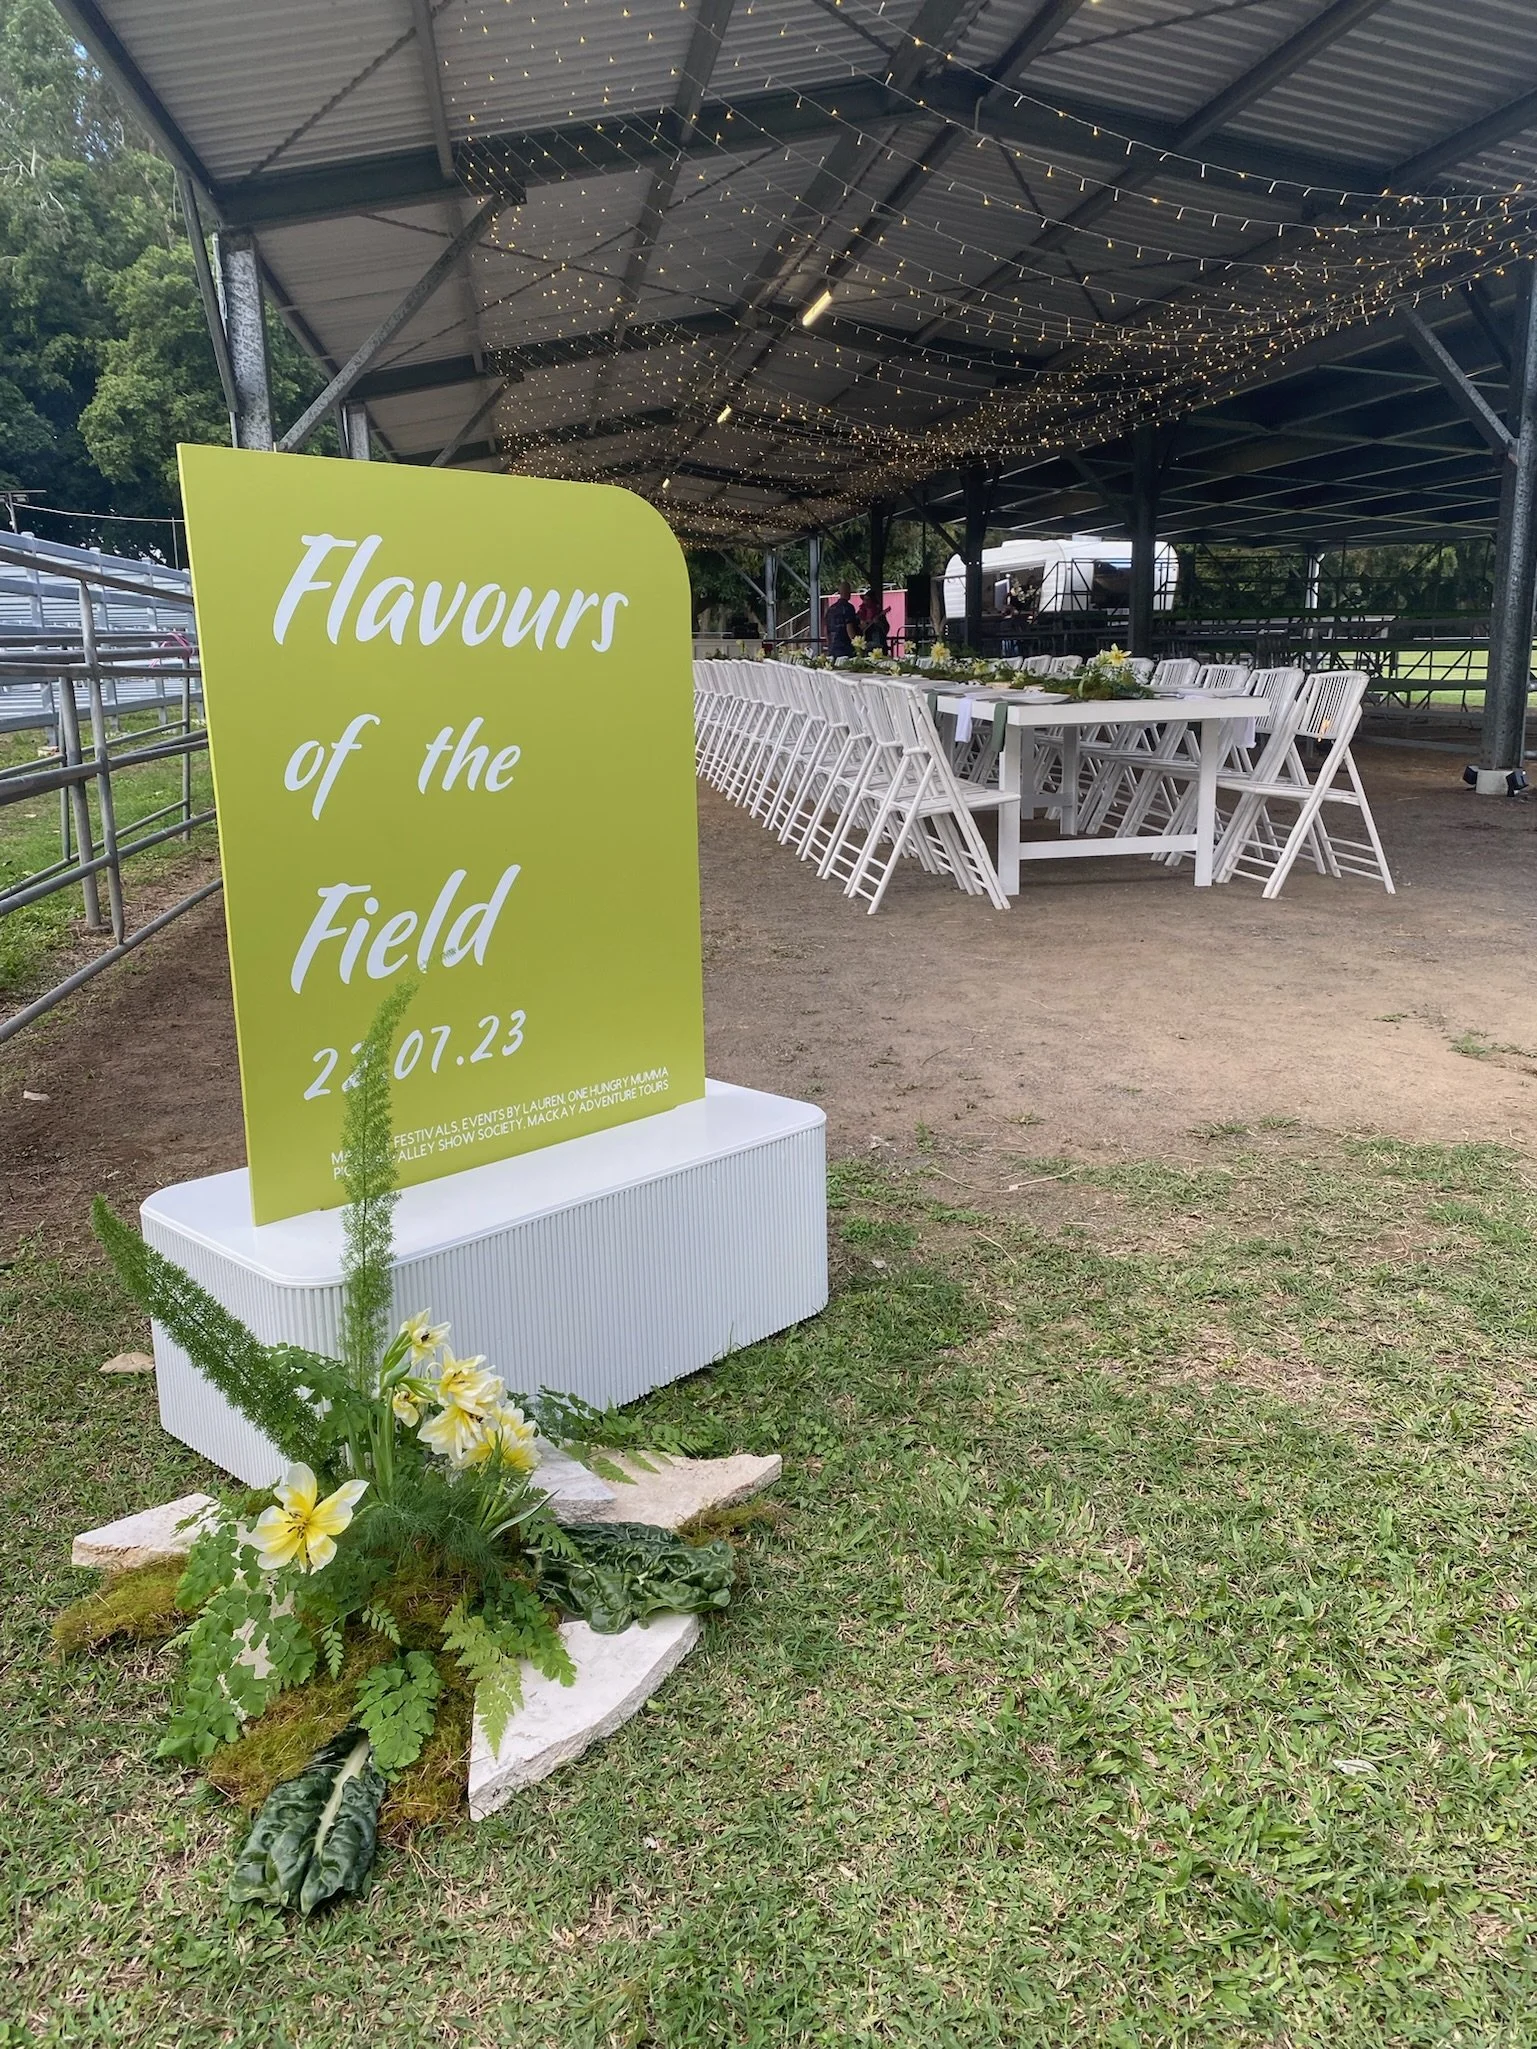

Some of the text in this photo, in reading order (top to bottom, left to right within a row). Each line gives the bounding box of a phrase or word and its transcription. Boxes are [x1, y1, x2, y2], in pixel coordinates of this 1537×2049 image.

[272, 532, 630, 653] Flavours
[284, 713, 522, 821] of the
[290, 863, 522, 994] Field
[438, 1130, 476, 1152] SHOW
[527, 1103, 578, 1128] MACKAY
[578, 1088, 637, 1114] ADVENTURE
[637, 1078, 669, 1097] TOURS
[463, 1109, 506, 1132] EVENTS
[506, 1103, 521, 1119] BY
[567, 1086, 589, 1104] ONE
[589, 1075, 630, 1098] HUNGRY
[629, 1066, 669, 1087] MUMMA
